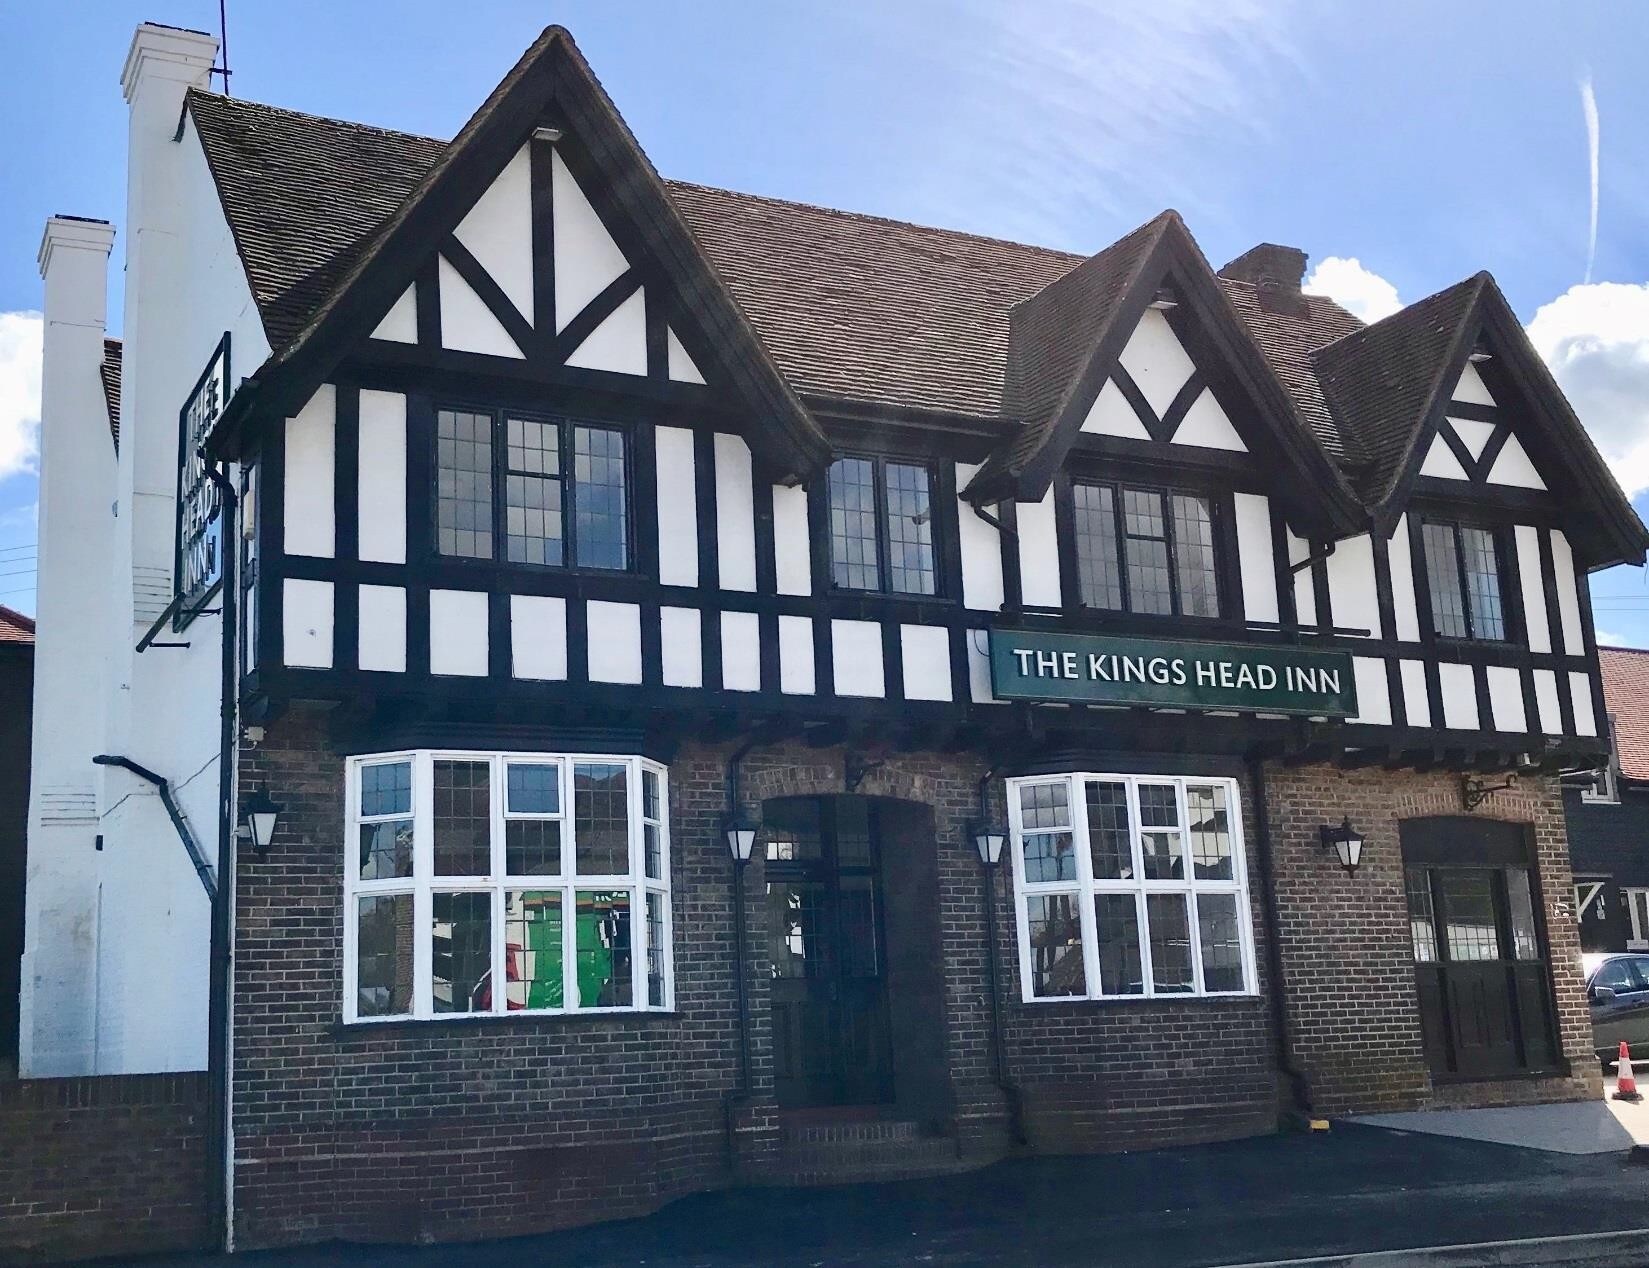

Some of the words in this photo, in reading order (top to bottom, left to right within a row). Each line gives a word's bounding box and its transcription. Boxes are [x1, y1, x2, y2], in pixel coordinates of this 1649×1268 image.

[182, 450, 207, 502] KIN
[182, 479, 213, 549] HEAD
[184, 533, 208, 594] INN
[1013, 648, 1079, 680] THE
[1088, 653, 1187, 685] KINGS
[1195, 659, 1277, 691] HEAD
[1285, 666, 1341, 695] INN
